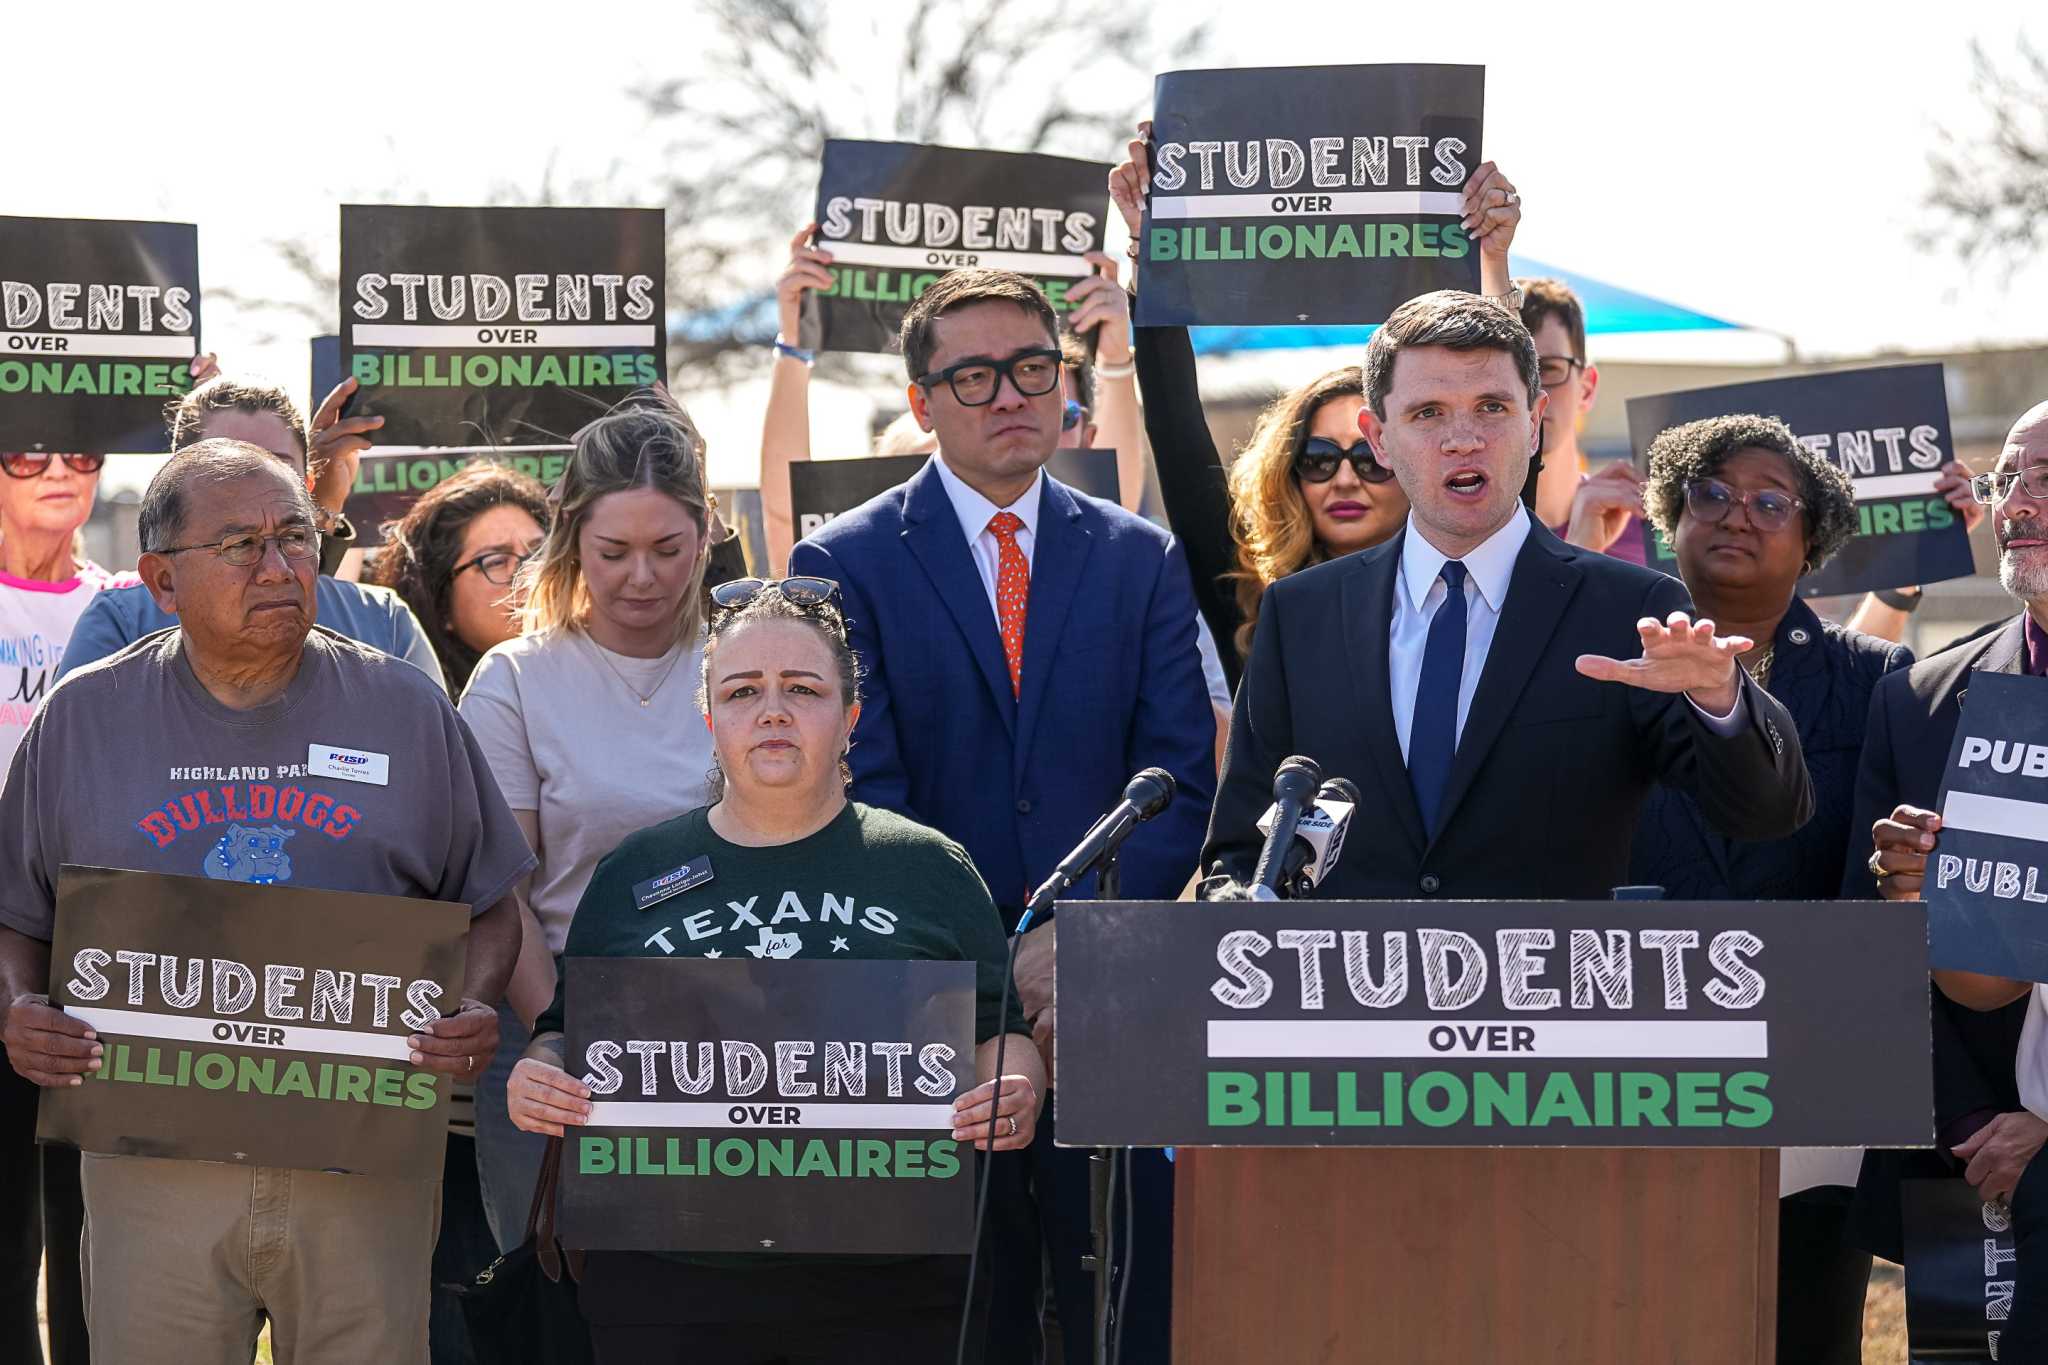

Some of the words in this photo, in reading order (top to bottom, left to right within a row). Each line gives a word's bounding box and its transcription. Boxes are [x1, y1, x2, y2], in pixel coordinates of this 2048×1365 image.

[1152, 136, 1467, 191] STUDENTS
[1271, 196, 1332, 213] OVER
[821, 196, 1096, 254] STUDENTS
[1150, 223, 1469, 261] BILLIONAIRES
[926, 252, 979, 268] OVER
[352, 273, 655, 322] STUDENTS
[8, 336, 69, 351] OVER
[477, 329, 537, 344] OVER
[352, 354, 658, 387] BILLIONAIRES
[170, 766, 270, 781] HIGHLAND
[276, 763, 309, 779] PAR
[137, 783, 362, 849] BULLDOGS
[644, 891, 899, 954] TEXANS
[766, 937, 791, 954] for
[66, 948, 443, 1031] STUDENTS
[1210, 928, 1766, 1011] STUDENTS
[212, 1022, 286, 1046] OVER
[1428, 1026, 1536, 1052] OVER
[84, 1044, 438, 1111] ILLIONAIRES
[582, 1040, 957, 1098] STUDENTS
[728, 1106, 800, 1125] OVER
[1207, 1071, 1774, 1128] BILLIONAIRES
[579, 1137, 960, 1179] BILLIONAIRES
